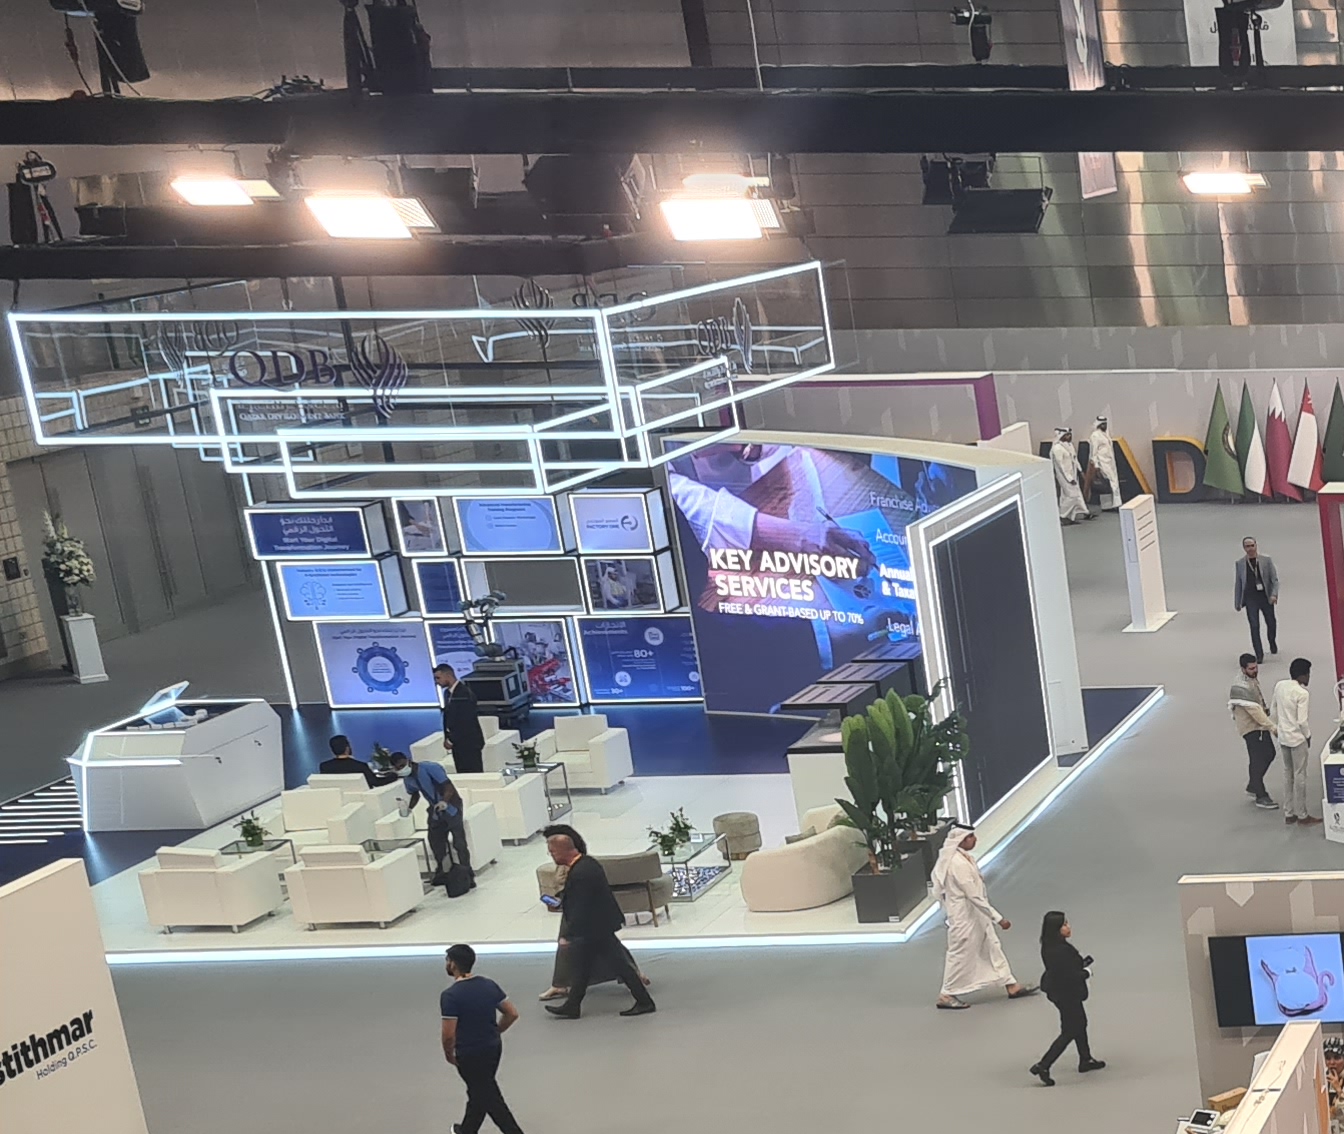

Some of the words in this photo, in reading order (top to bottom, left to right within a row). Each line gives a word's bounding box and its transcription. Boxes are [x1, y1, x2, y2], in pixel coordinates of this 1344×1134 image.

[229, 350, 337, 391] QDB
[870, 492, 913, 511] Franchise
[710, 549, 753, 571] KEY
[760, 552, 859, 580] ADVISORY
[715, 575, 814, 601] SERVICES
[882, 583, 890, 596] &
[892, 583, 915, 600] Taxa
[719, 602, 744, 615] FREE
[744, 604, 753, 615] &
[754, 604, 819, 621] GRANT-BASED
[819, 610, 832, 622] UP
[833, 611, 846, 623] TO
[847, 612, 864, 625] 70%
[888, 617, 914, 637] Legal
[36, 1057, 68, 1080] Holding
